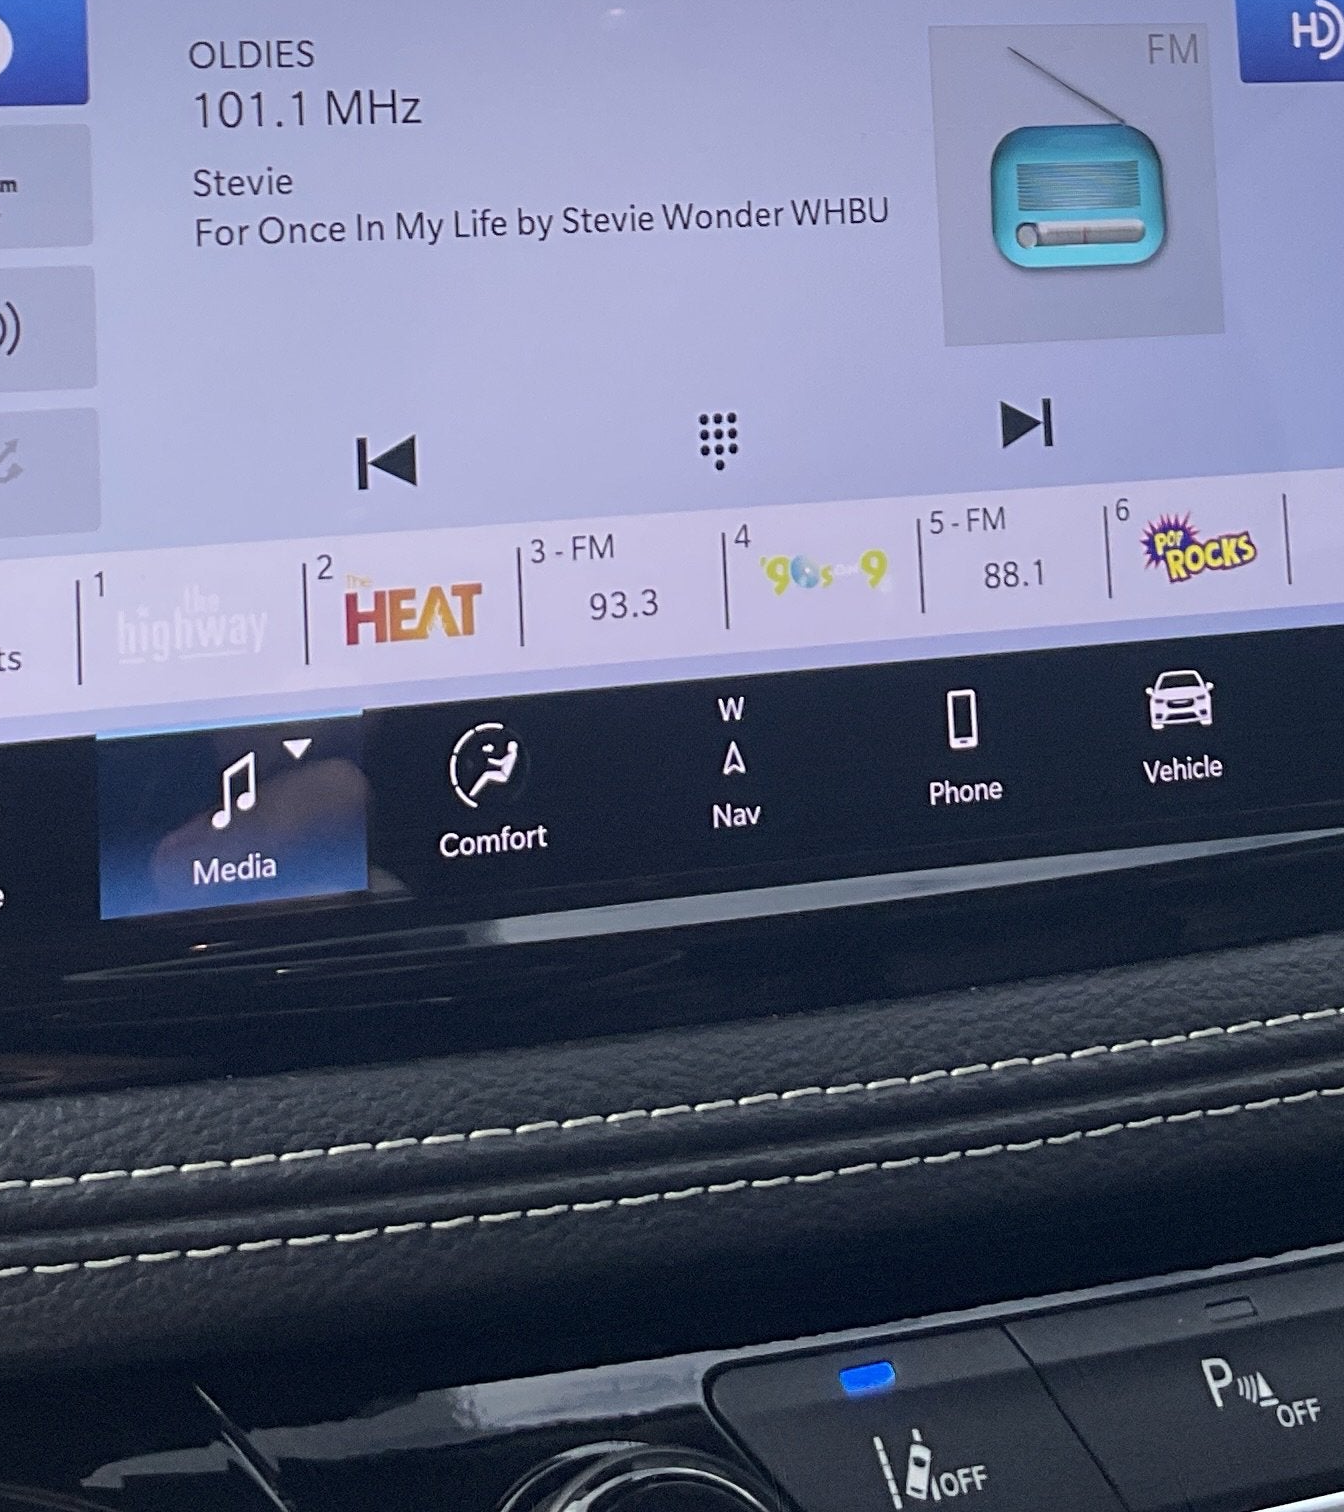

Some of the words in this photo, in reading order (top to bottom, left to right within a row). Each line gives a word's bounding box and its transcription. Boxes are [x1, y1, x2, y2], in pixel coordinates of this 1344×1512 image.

[189, 40, 315, 69] OLDIES
[1148, 33, 1199, 65] FM
[195, 90, 305, 128] 101.1
[326, 89, 422, 126] MHz
[193, 167, 293, 197] Stevie
[196, 218, 249, 247] For
[258, 216, 346, 246] Once
[356, 213, 385, 241] In
[396, 211, 444, 245] My
[454, 209, 508, 238] Life
[517, 207, 553, 241] by
[562, 204, 654, 234] Stevie
[662, 201, 785, 230] Wonder
[791, 196, 889, 226] WHBU
[929, 511, 945, 535] 5
[967, 506, 1006, 532] FM
[1115, 498, 1131, 522] 6
[531, 539, 546, 564] 3
[572, 534, 615, 561] FM
[733, 523, 752, 549] 4
[316, 554, 334, 581] 2
[860, 548, 889, 589] 9
[1166, 533, 1256, 582] ROCKS
[93, 571, 105, 597] 1
[984, 559, 1044, 589] 88.1
[183, 585, 220, 614] the
[345, 582, 483, 646] HEAT
[589, 588, 659, 621] 93.3
[118, 604, 268, 663] highway
[718, 696, 745, 722] W
[1143, 754, 1224, 785] Vehicle
[929, 778, 1003, 806] Phone
[712, 803, 762, 829] Nav
[439, 825, 548, 859] Comfort
[193, 854, 278, 886] Media
[1201, 1358, 1234, 1408] P
[1276, 1397, 1322, 1428] OFF
[938, 1464, 989, 1498] OFF
